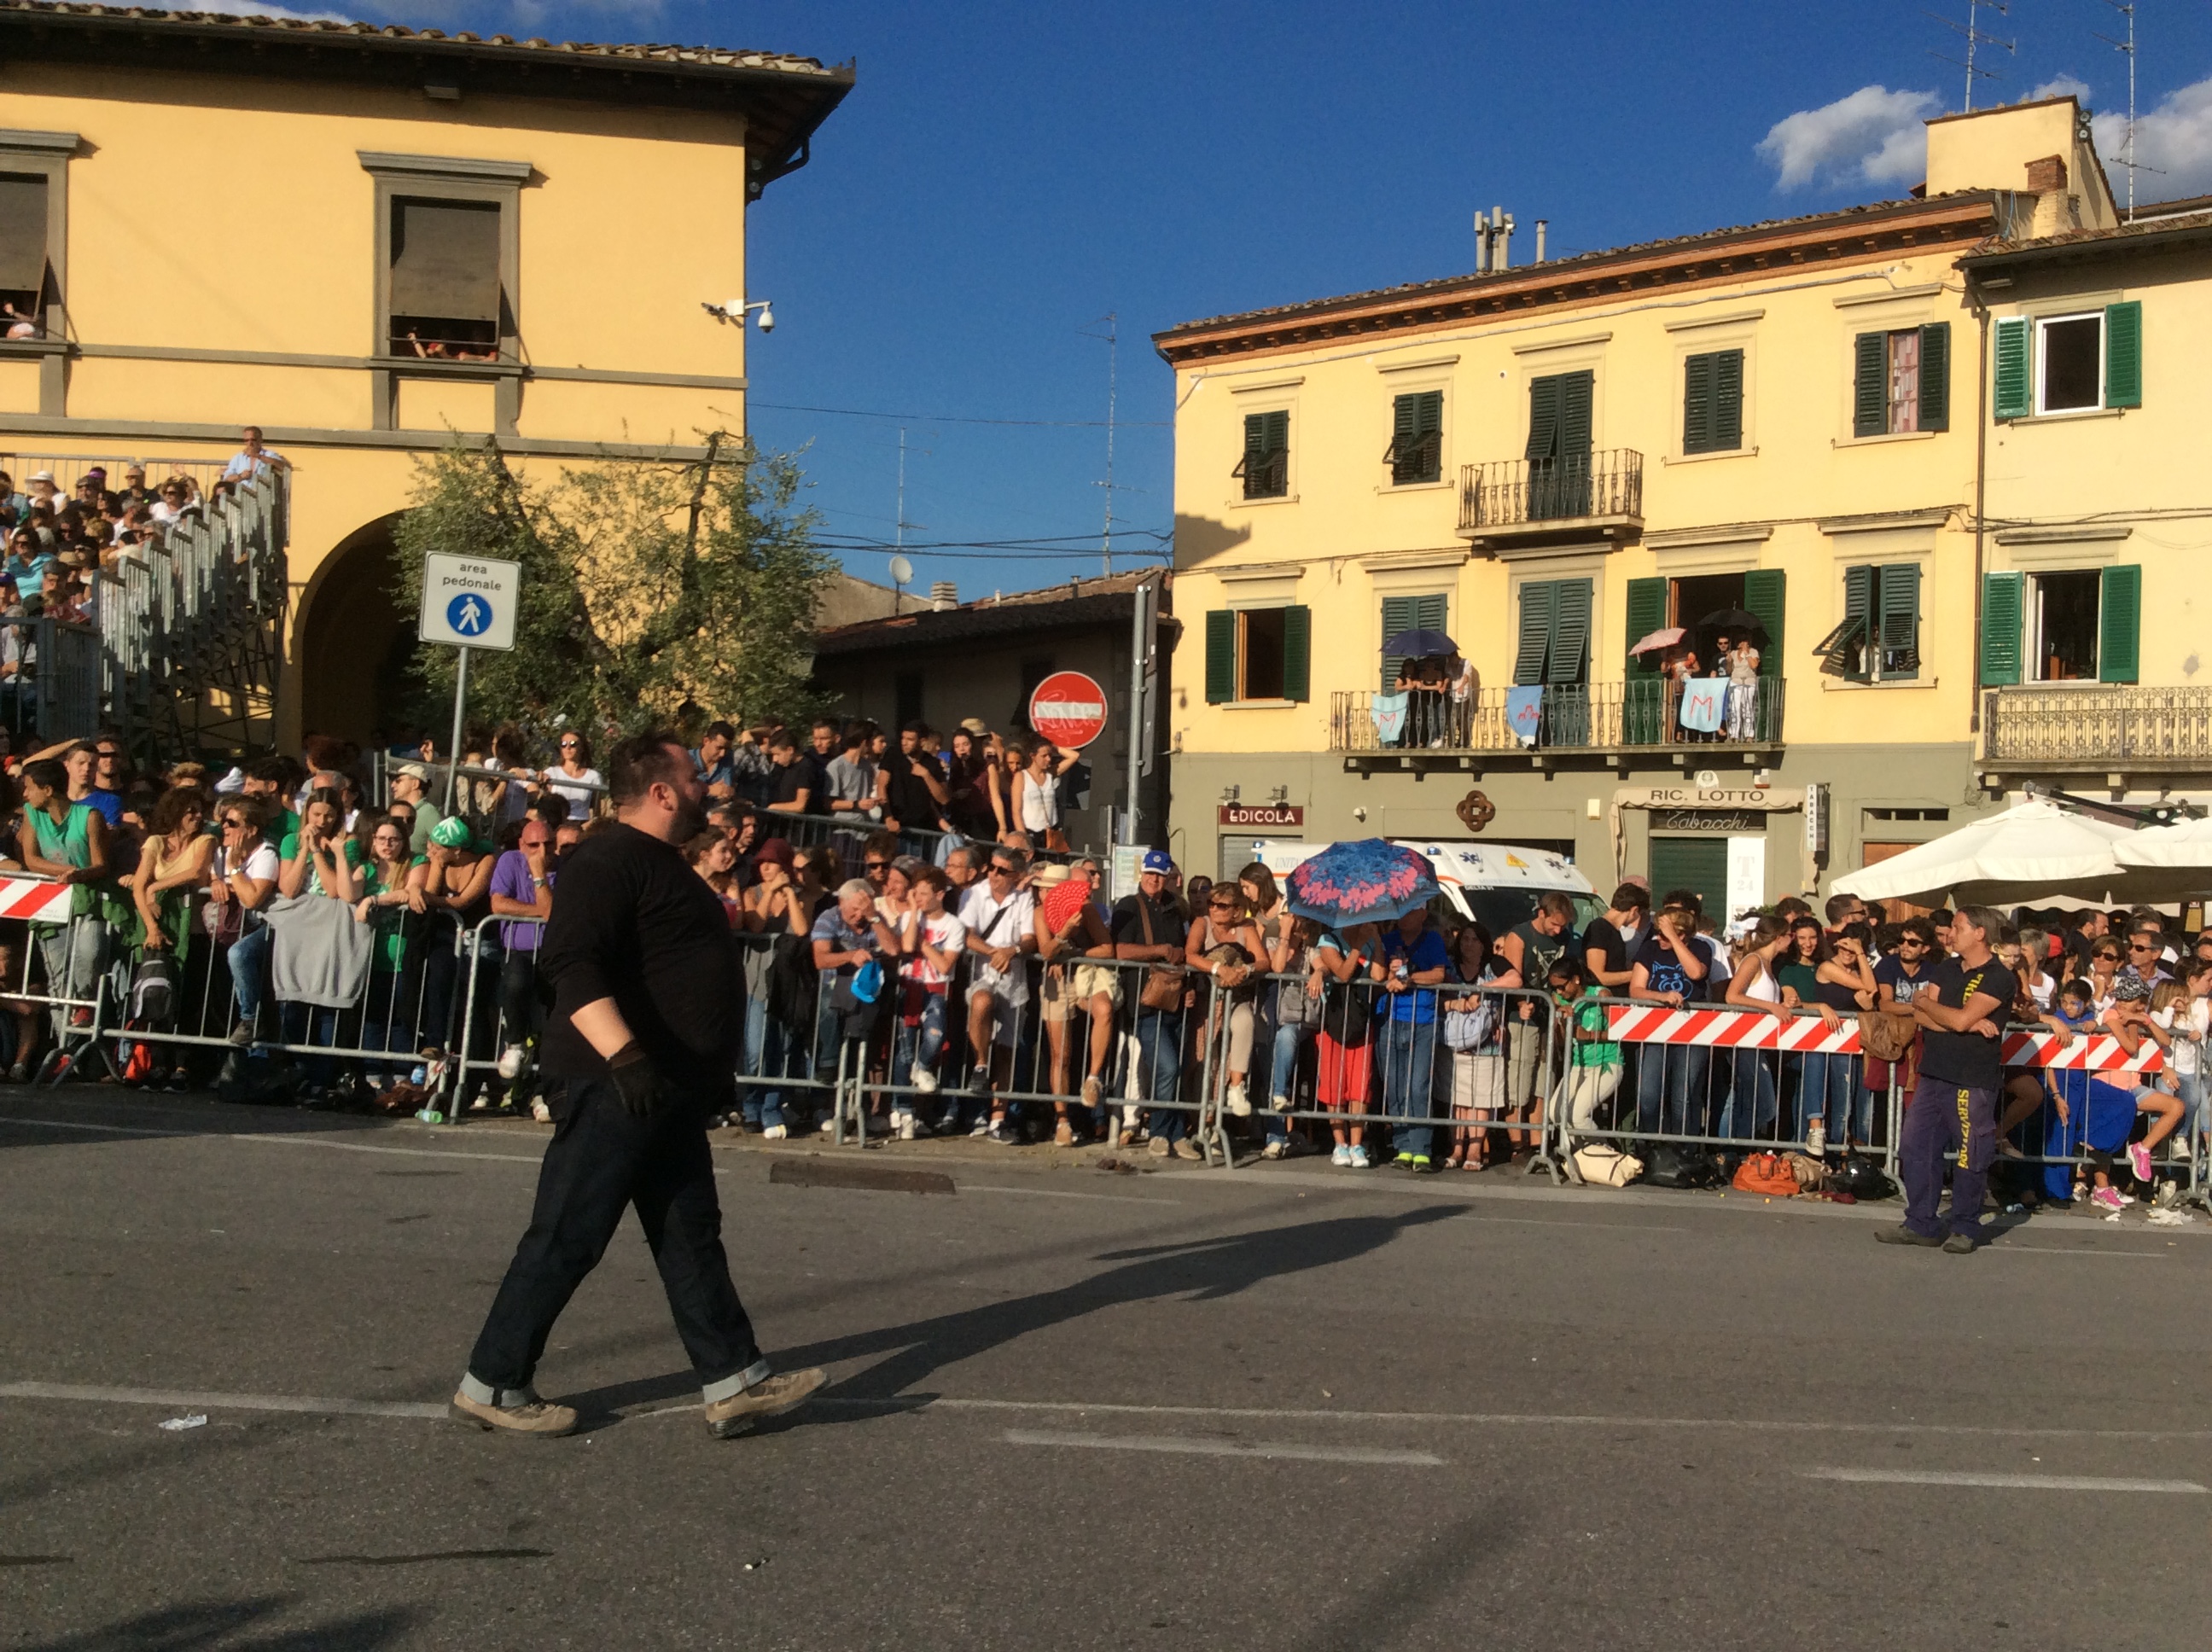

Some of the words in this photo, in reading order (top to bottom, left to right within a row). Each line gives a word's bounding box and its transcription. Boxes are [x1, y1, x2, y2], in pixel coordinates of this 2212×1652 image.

[459, 563, 487, 574] area
[442, 577, 502, 591] pedonale
[1650, 789, 1688, 800] RIC.
[1698, 790, 1765, 802] LOTTO
[1229, 810, 1295, 823] EDICOLA
[1666, 811, 1751, 831] Tabacchi
[1737, 856, 1755, 877] T
[1737, 880, 1755, 891] 24
